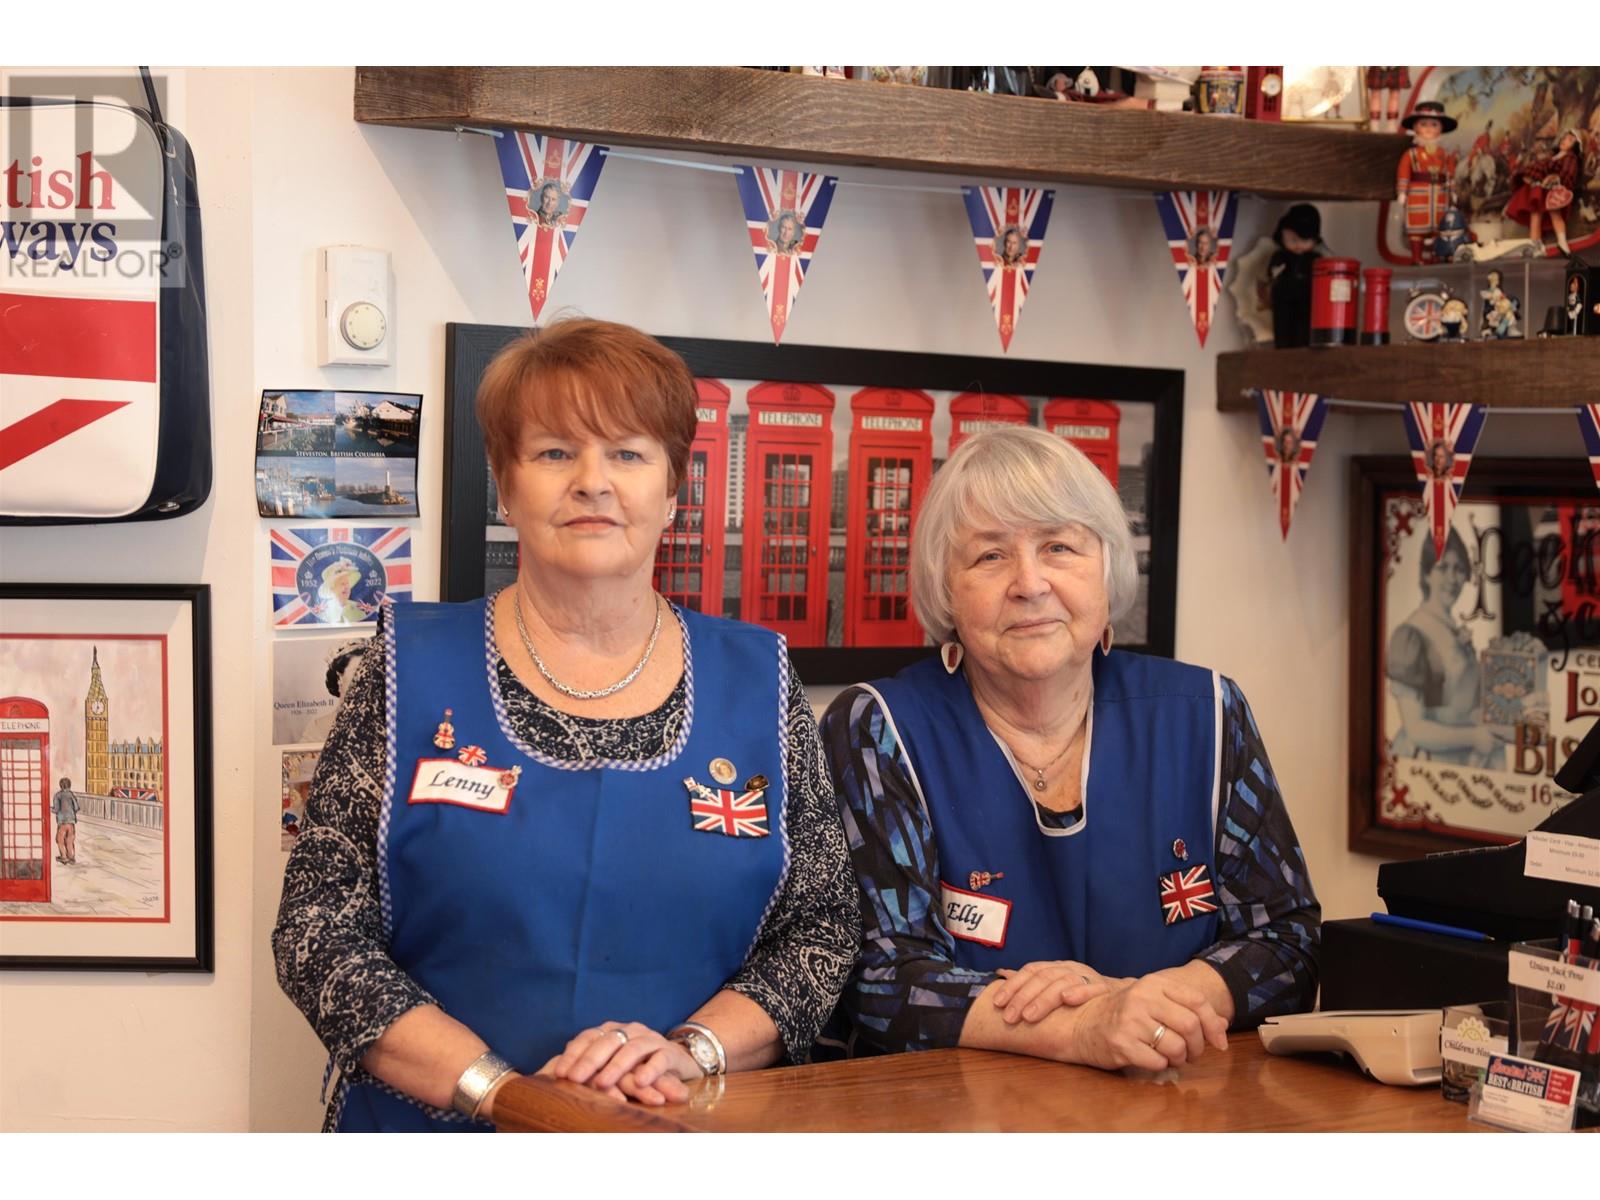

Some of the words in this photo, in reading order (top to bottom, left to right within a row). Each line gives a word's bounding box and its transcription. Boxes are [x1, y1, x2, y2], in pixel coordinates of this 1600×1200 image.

[761, 411, 821, 426] TELEPHONE
[863, 416, 921, 431] TELEPHONE
[330, 450, 354, 458] BRITISH
[354, 450, 386, 458] COLUMBIA
[365, 577, 382, 587] 2022
[273, 701, 296, 710] Queen
[297, 699, 327, 708] Elizabeth
[427, 769, 496, 800] Lenny
[1530, 783, 1552, 805] 16
[947, 902, 984, 931] Elly
[1529, 960, 1551, 973] Union
[1551, 965, 1568, 979] Jack
[1567, 969, 1585, 981] Pens
[1444, 1039, 1475, 1055] Childrens
[1487, 1073, 1509, 1090] BEST
[1511, 1078, 1544, 1099] BRITISH
